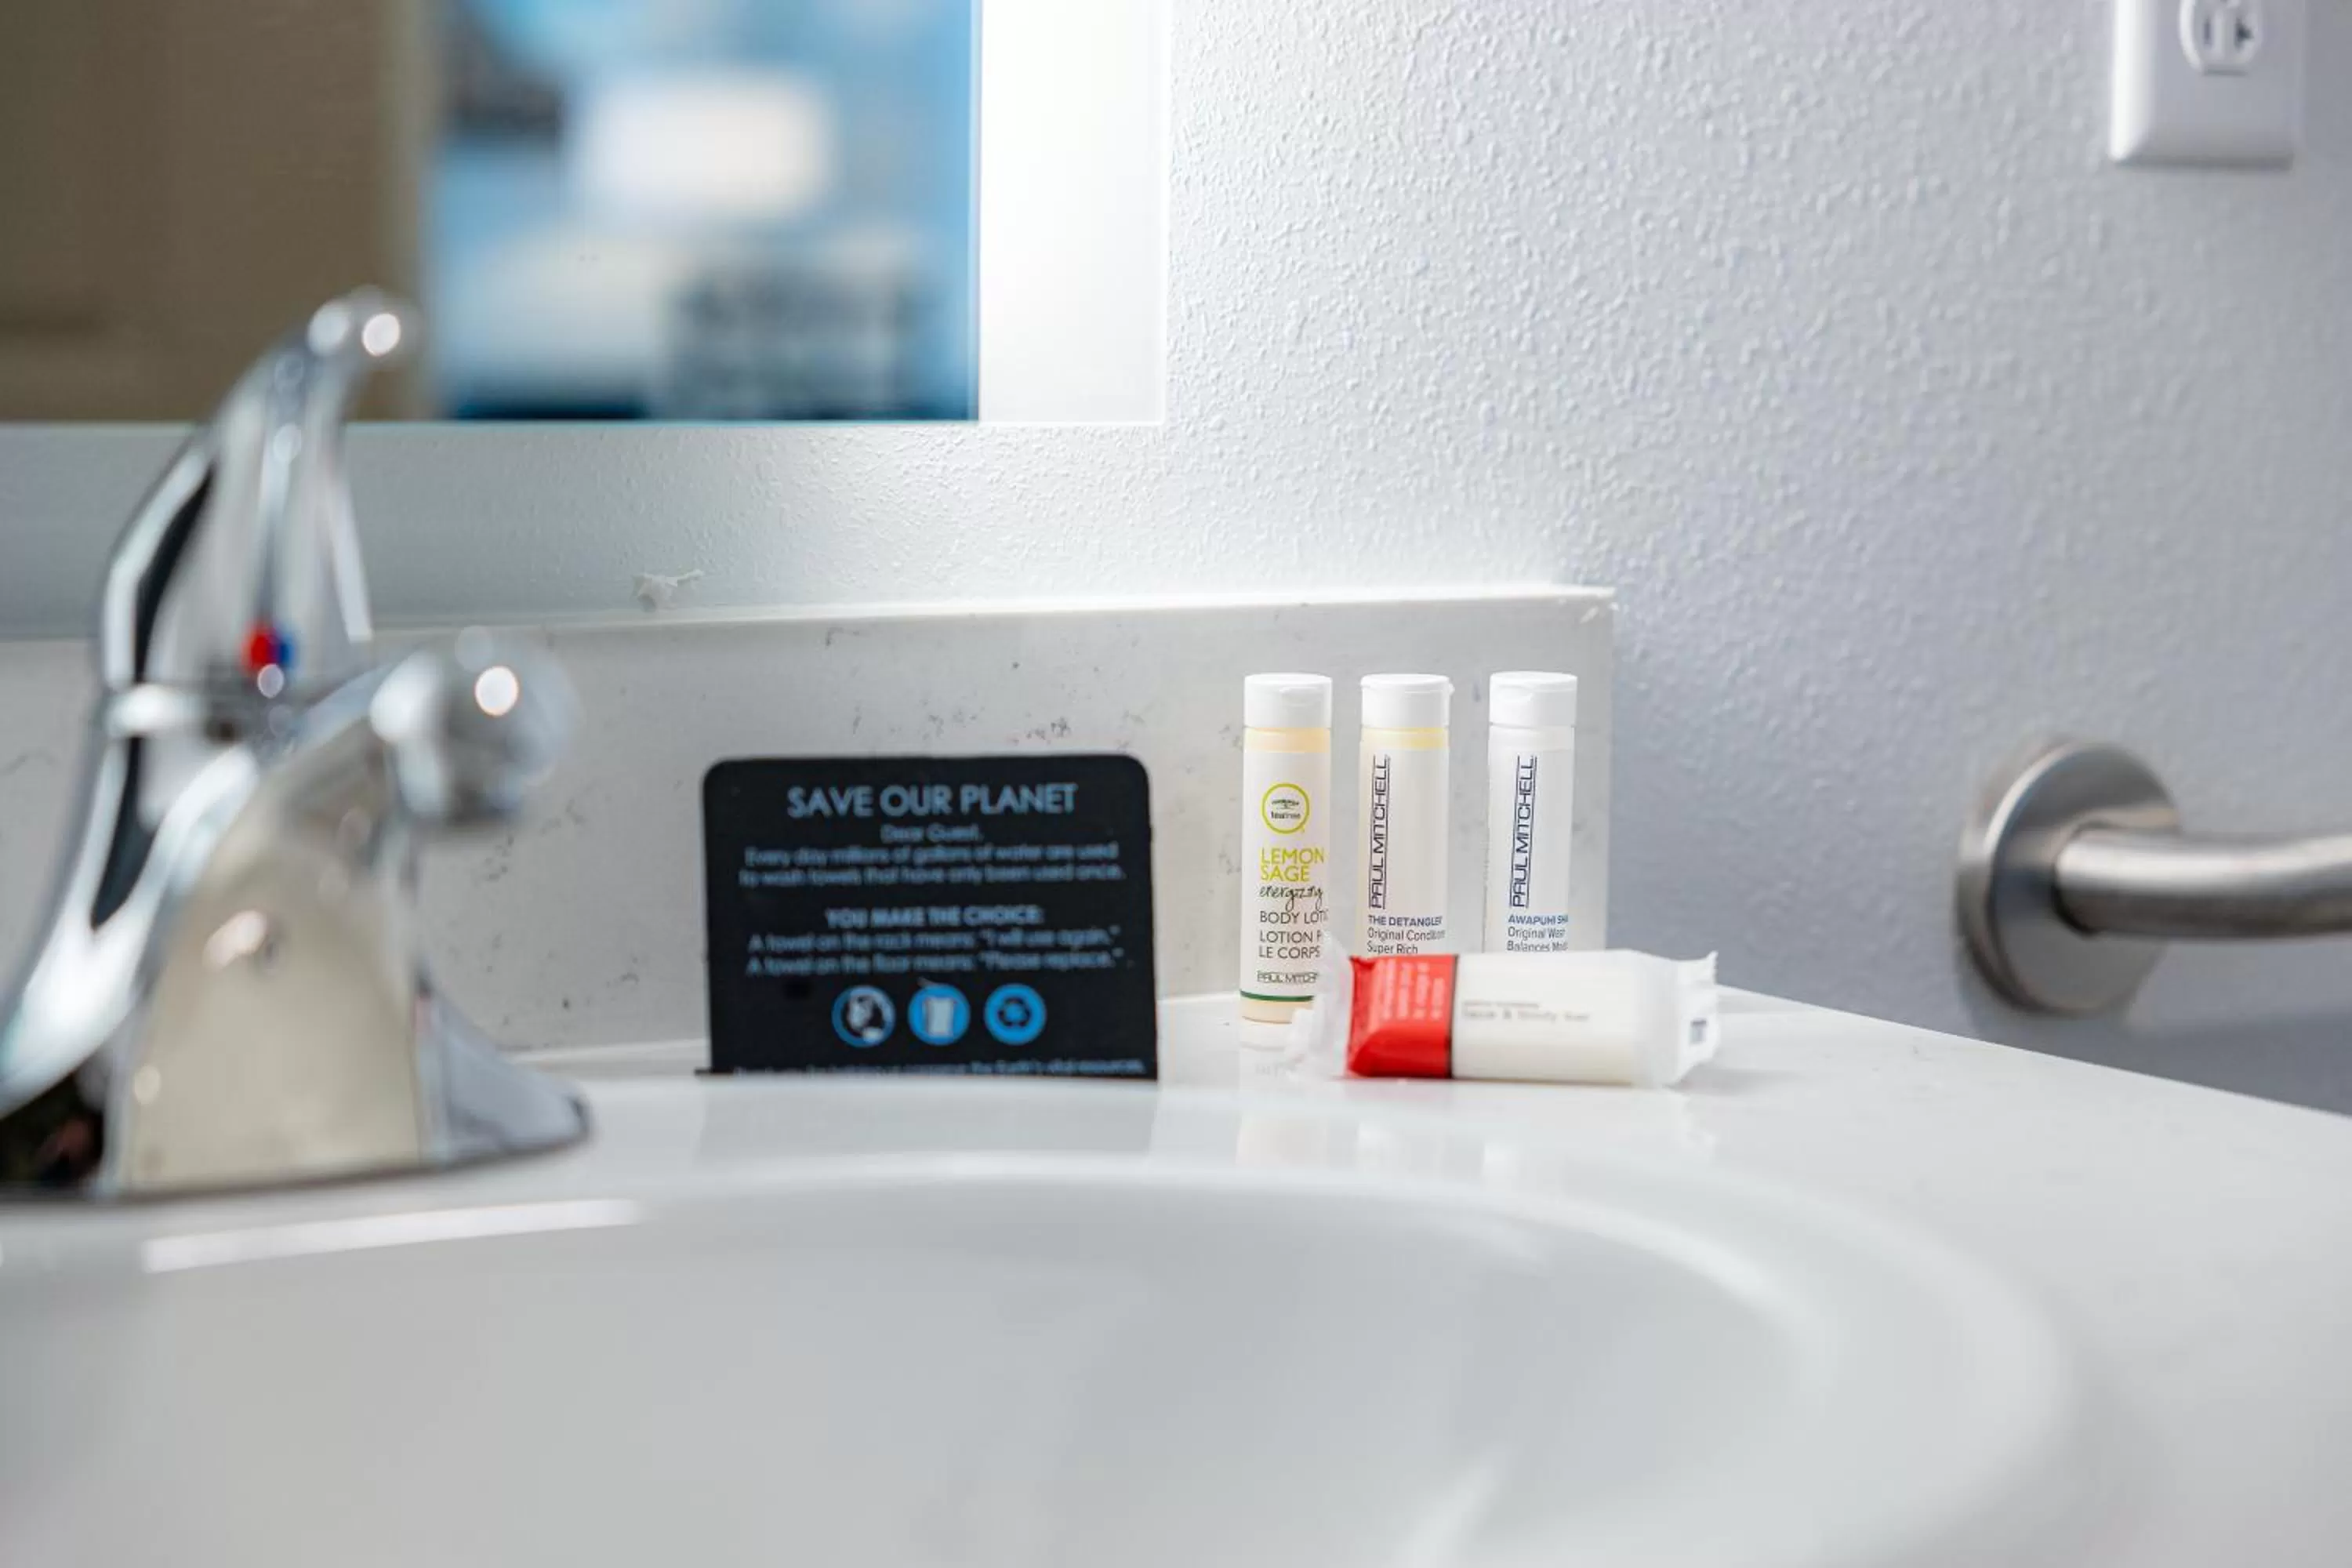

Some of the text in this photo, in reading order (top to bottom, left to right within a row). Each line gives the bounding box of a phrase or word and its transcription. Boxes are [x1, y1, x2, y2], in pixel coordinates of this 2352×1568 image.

[787, 782, 1079, 818] SAVE OUR PLANET
[1370, 754, 1388, 909] PAUL MITCHELL
[1512, 754, 1534, 907] PAUL MITCHELL
[1261, 847, 1325, 864] LEMON
[1261, 864, 1310, 882] SAGE
[1259, 885, 1324, 913] energizing
[1259, 910, 1301, 924] BODY
[1368, 914, 1387, 925] THE
[1508, 914, 1556, 926] AWAPUHI
[1259, 930, 1313, 943] LOTION
[1367, 927, 1404, 942] Original
[1508, 926, 1545, 941] Original
[1258, 945, 1321, 959] LE CORPS
[1367, 940, 1418, 954] Super Rich
[1506, 940, 1550, 953] Balances
